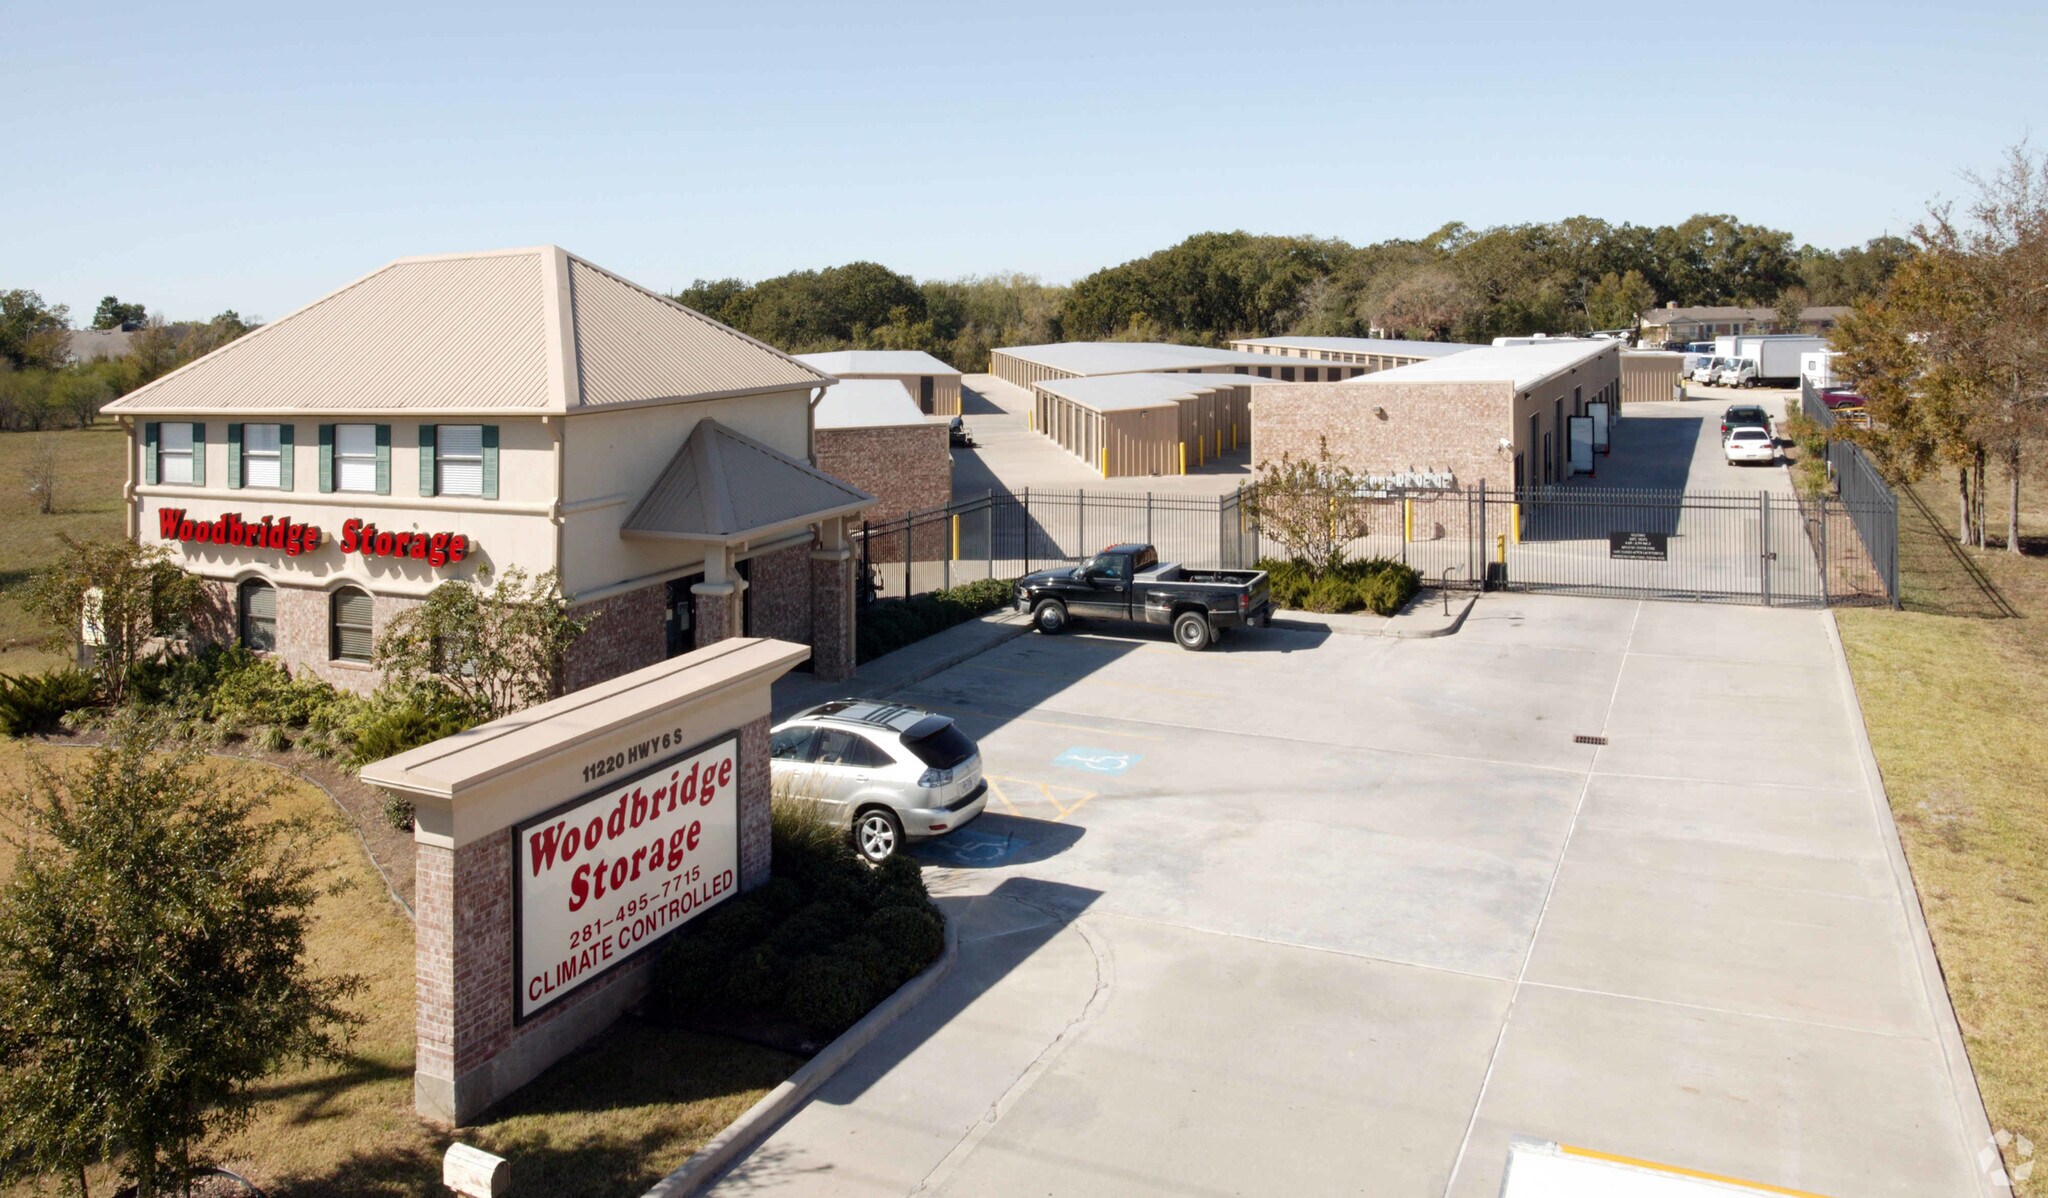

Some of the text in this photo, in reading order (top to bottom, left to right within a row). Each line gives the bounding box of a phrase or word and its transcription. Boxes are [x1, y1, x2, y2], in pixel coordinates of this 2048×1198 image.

[158, 507, 469, 568] Woodbridge Storage
[582, 752, 625, 783] 11220
[673, 728, 683, 745] S
[529, 757, 733, 878] Woodbridge
[568, 819, 702, 913] Storage
[569, 865, 701, 950] 281-495-7715
[528, 868, 733, 1002] CLIMATE CONTROLLED
